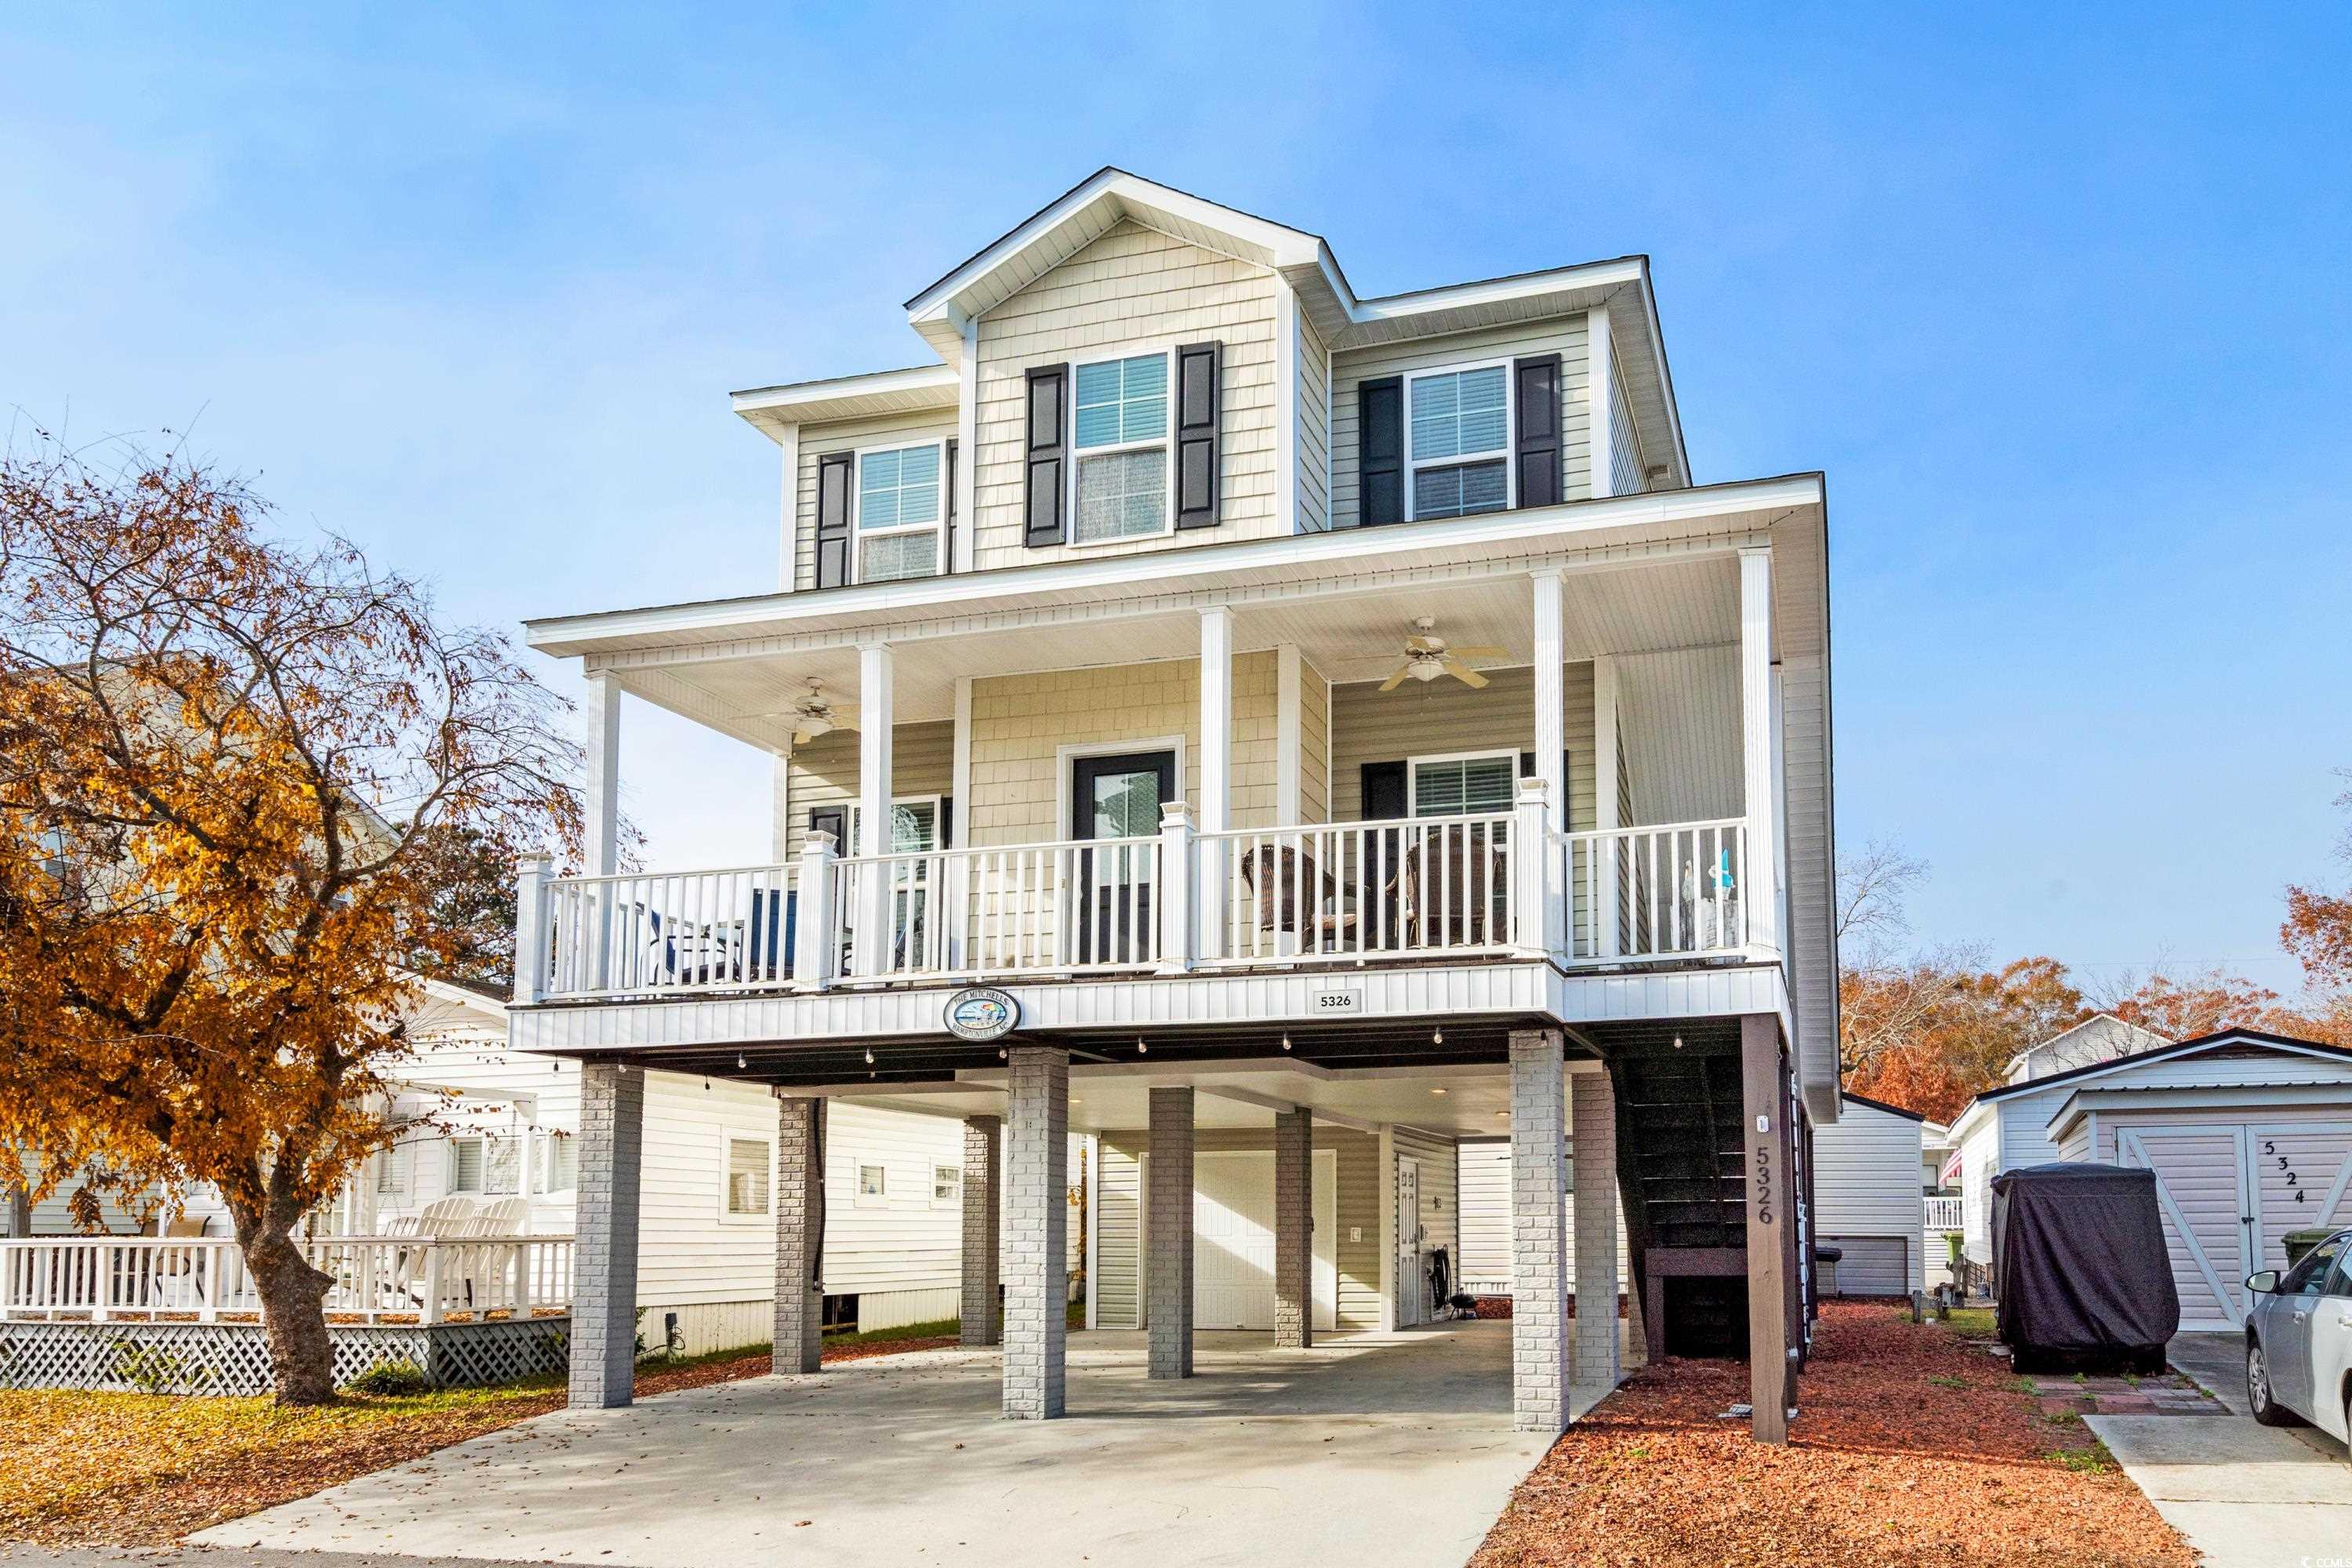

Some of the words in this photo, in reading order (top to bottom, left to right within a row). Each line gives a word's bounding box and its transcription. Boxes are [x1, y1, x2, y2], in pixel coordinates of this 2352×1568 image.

[954, 994, 967, 1004] THE
[970, 989, 1008, 1004] MITCHELLS
[1321, 996, 1351, 1007] 5326
[1756, 1147, 1773, 1225] 5326
[2265, 1142, 2305, 1203] 5324
